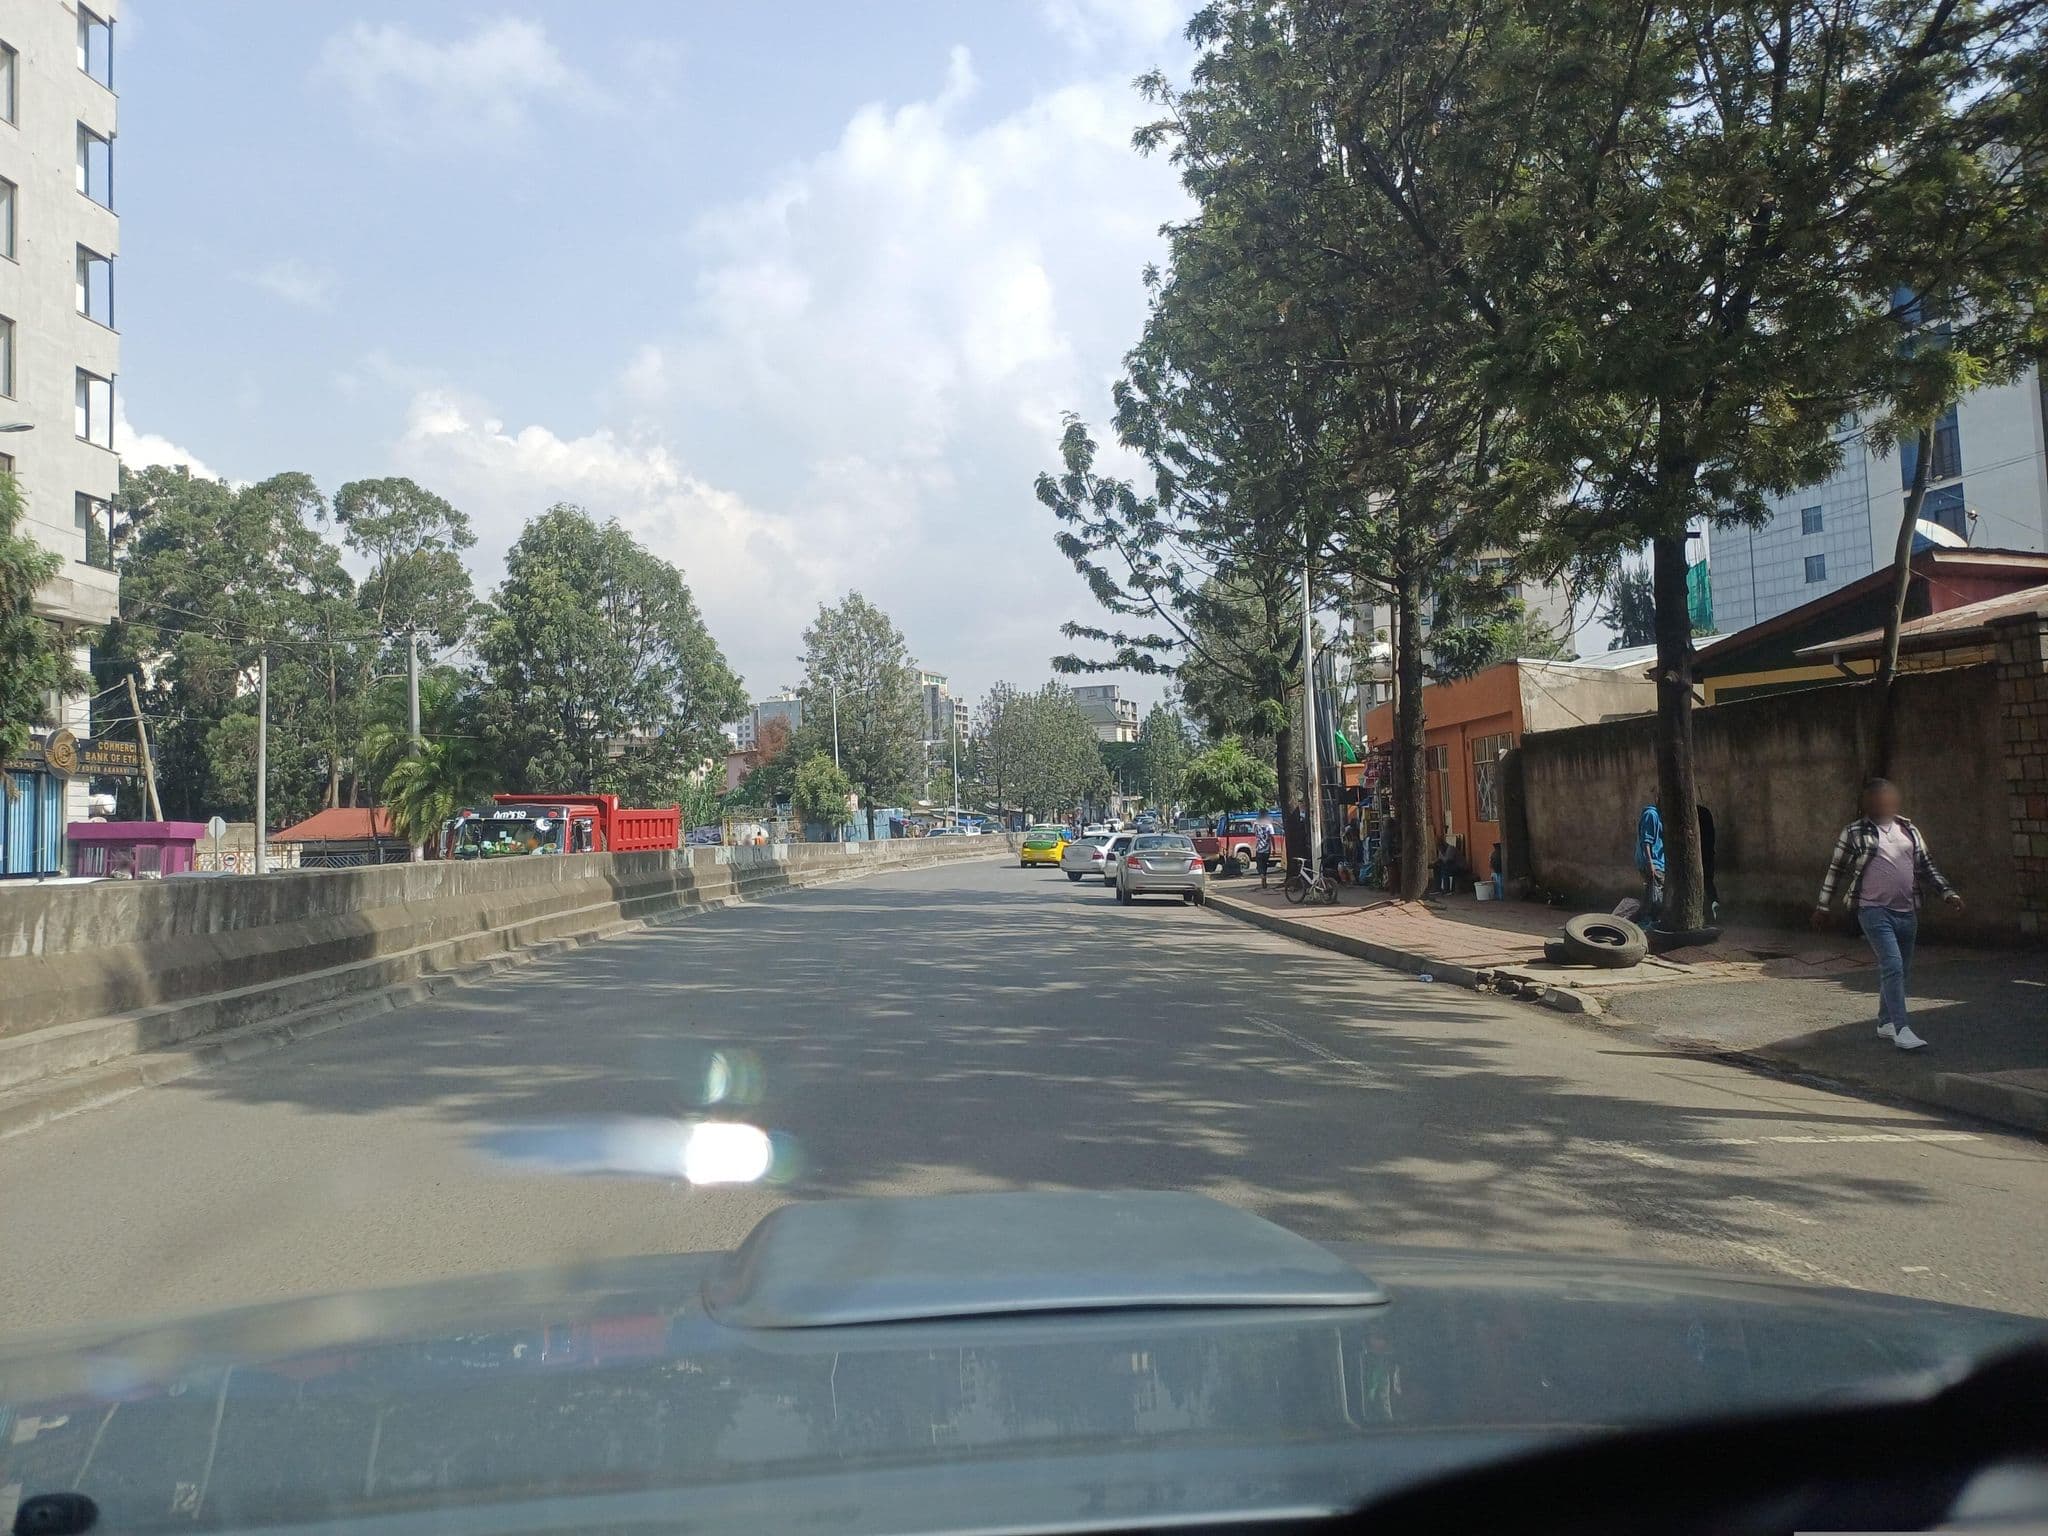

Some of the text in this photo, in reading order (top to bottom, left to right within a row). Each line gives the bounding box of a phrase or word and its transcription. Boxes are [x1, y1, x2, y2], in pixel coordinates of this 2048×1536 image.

[98, 741, 143, 754] COMMERCIA
[85, 751, 108, 763] BANK
[110, 753, 120, 763] OF
